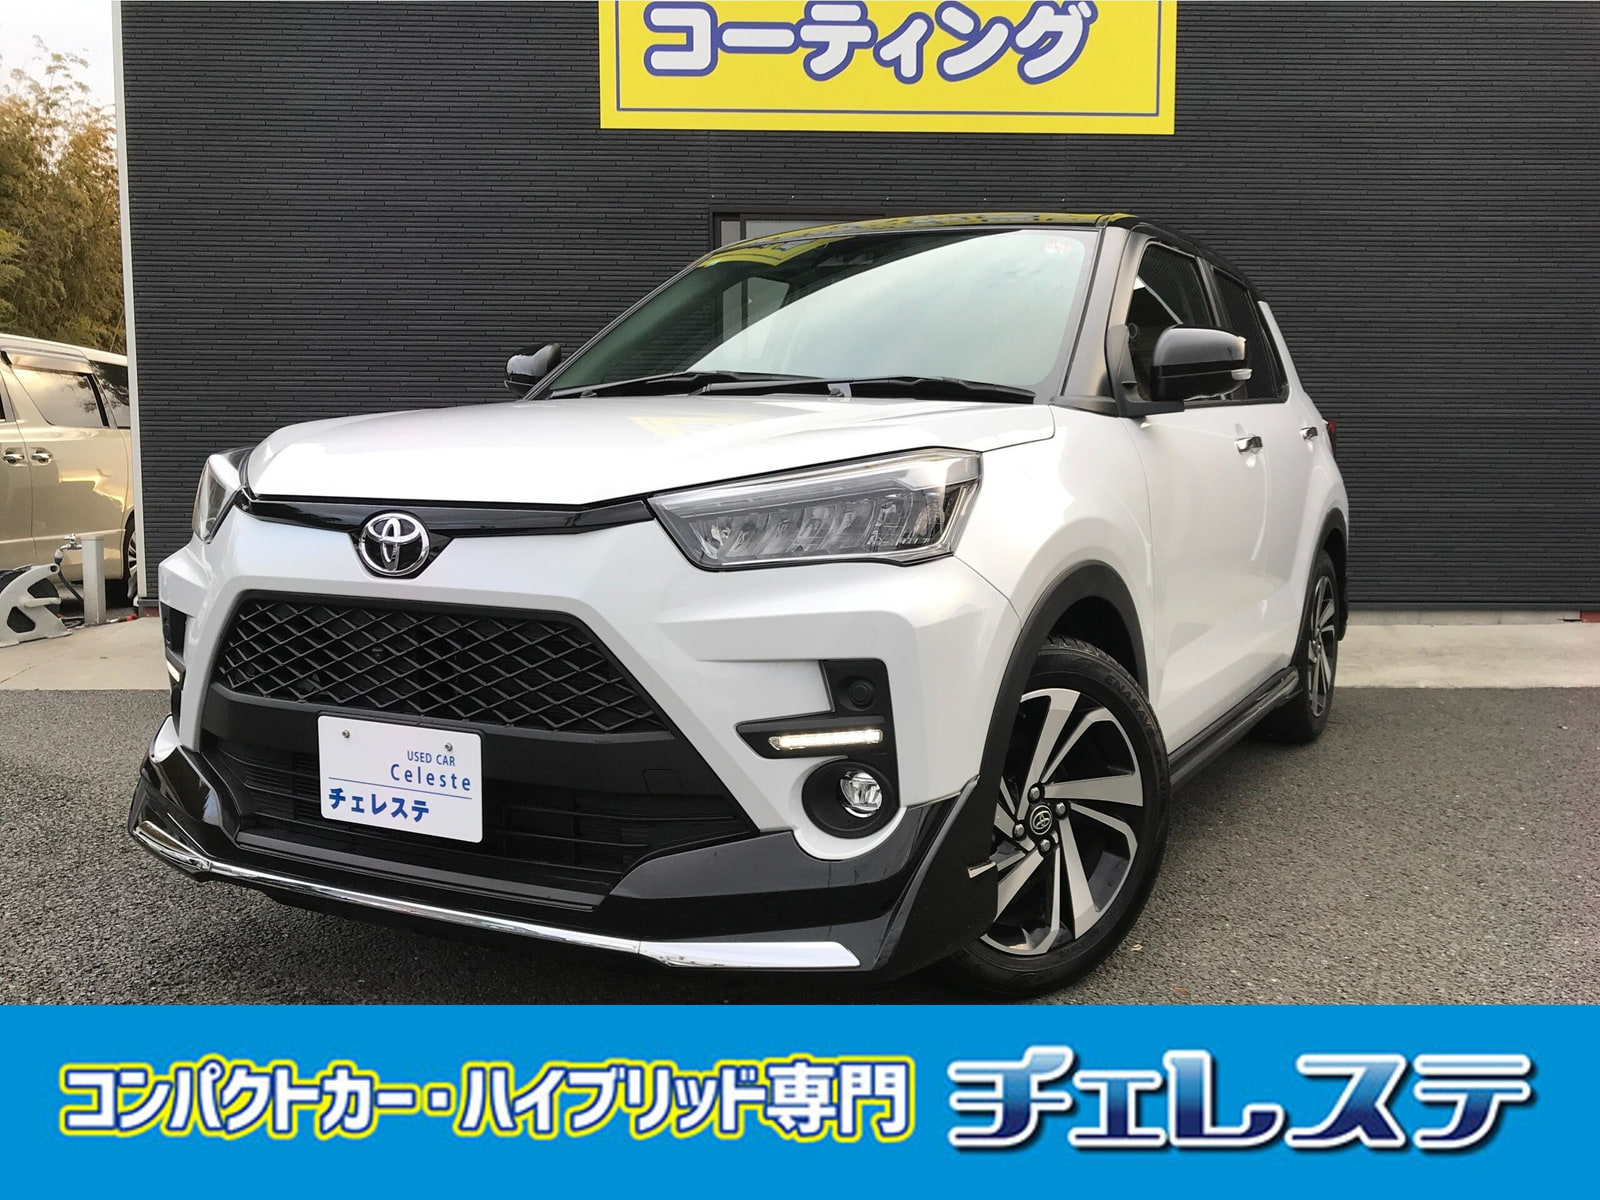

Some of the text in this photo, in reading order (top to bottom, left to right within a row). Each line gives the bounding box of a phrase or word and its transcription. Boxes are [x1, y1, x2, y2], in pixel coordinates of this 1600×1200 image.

[644, 1, 1098, 84] コーティング
[407, 750, 456, 766] USED CAR
[390, 763, 471, 791] Celeste
[328, 787, 429, 822] チェレステ
